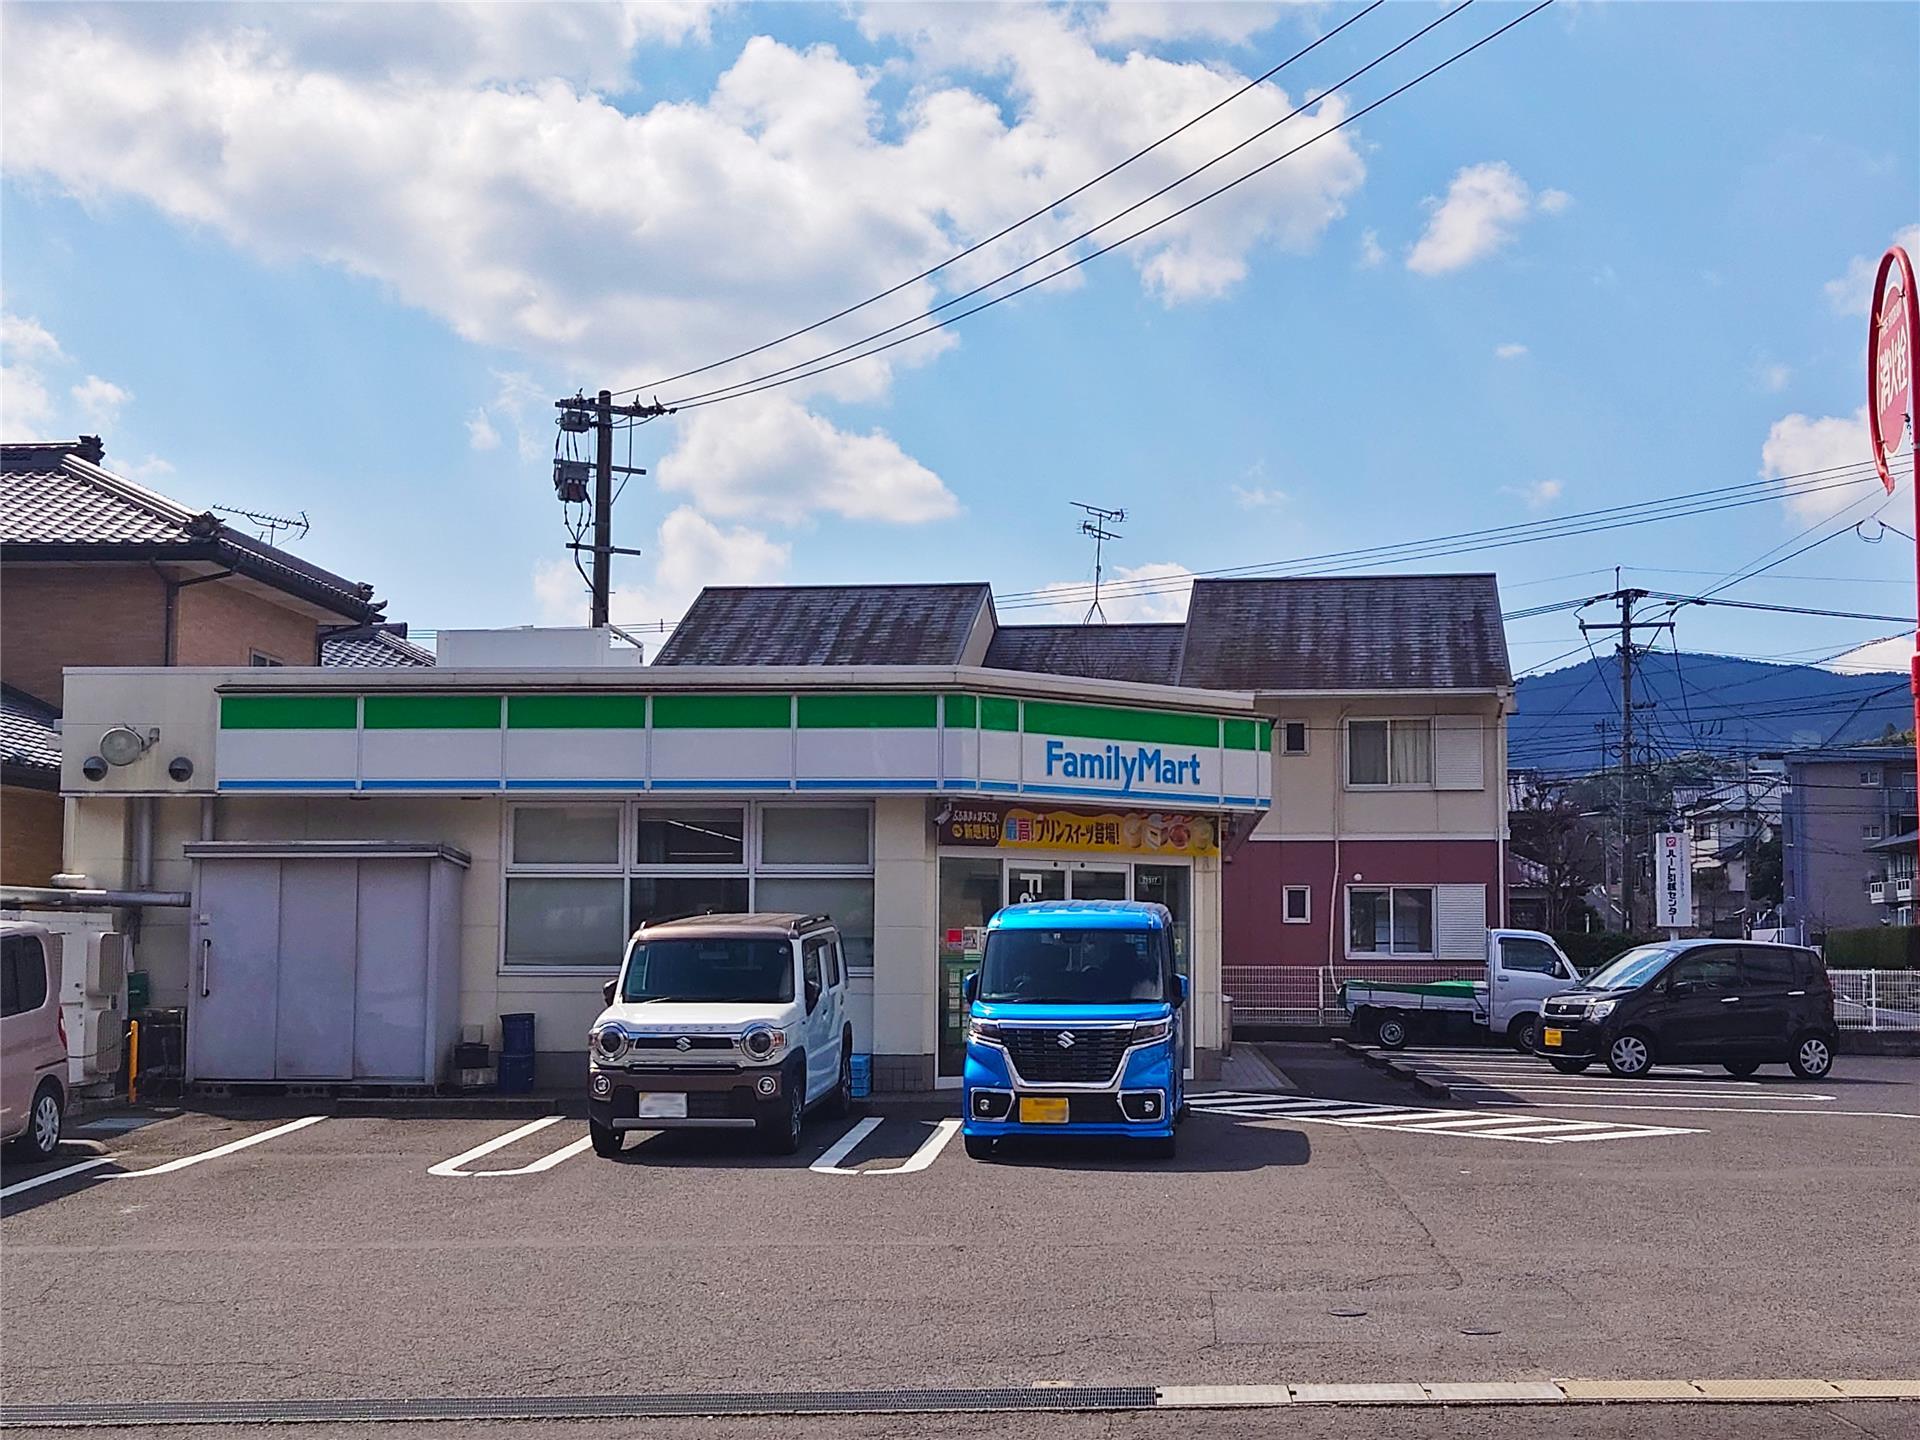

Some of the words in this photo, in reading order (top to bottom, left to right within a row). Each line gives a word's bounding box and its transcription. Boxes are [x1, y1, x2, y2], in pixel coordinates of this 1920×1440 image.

[1879, 326, 1908, 414] 消火栓
[1046, 740, 1201, 793] FamilyMart
[1666, 849, 1677, 924] ハート引越センター
